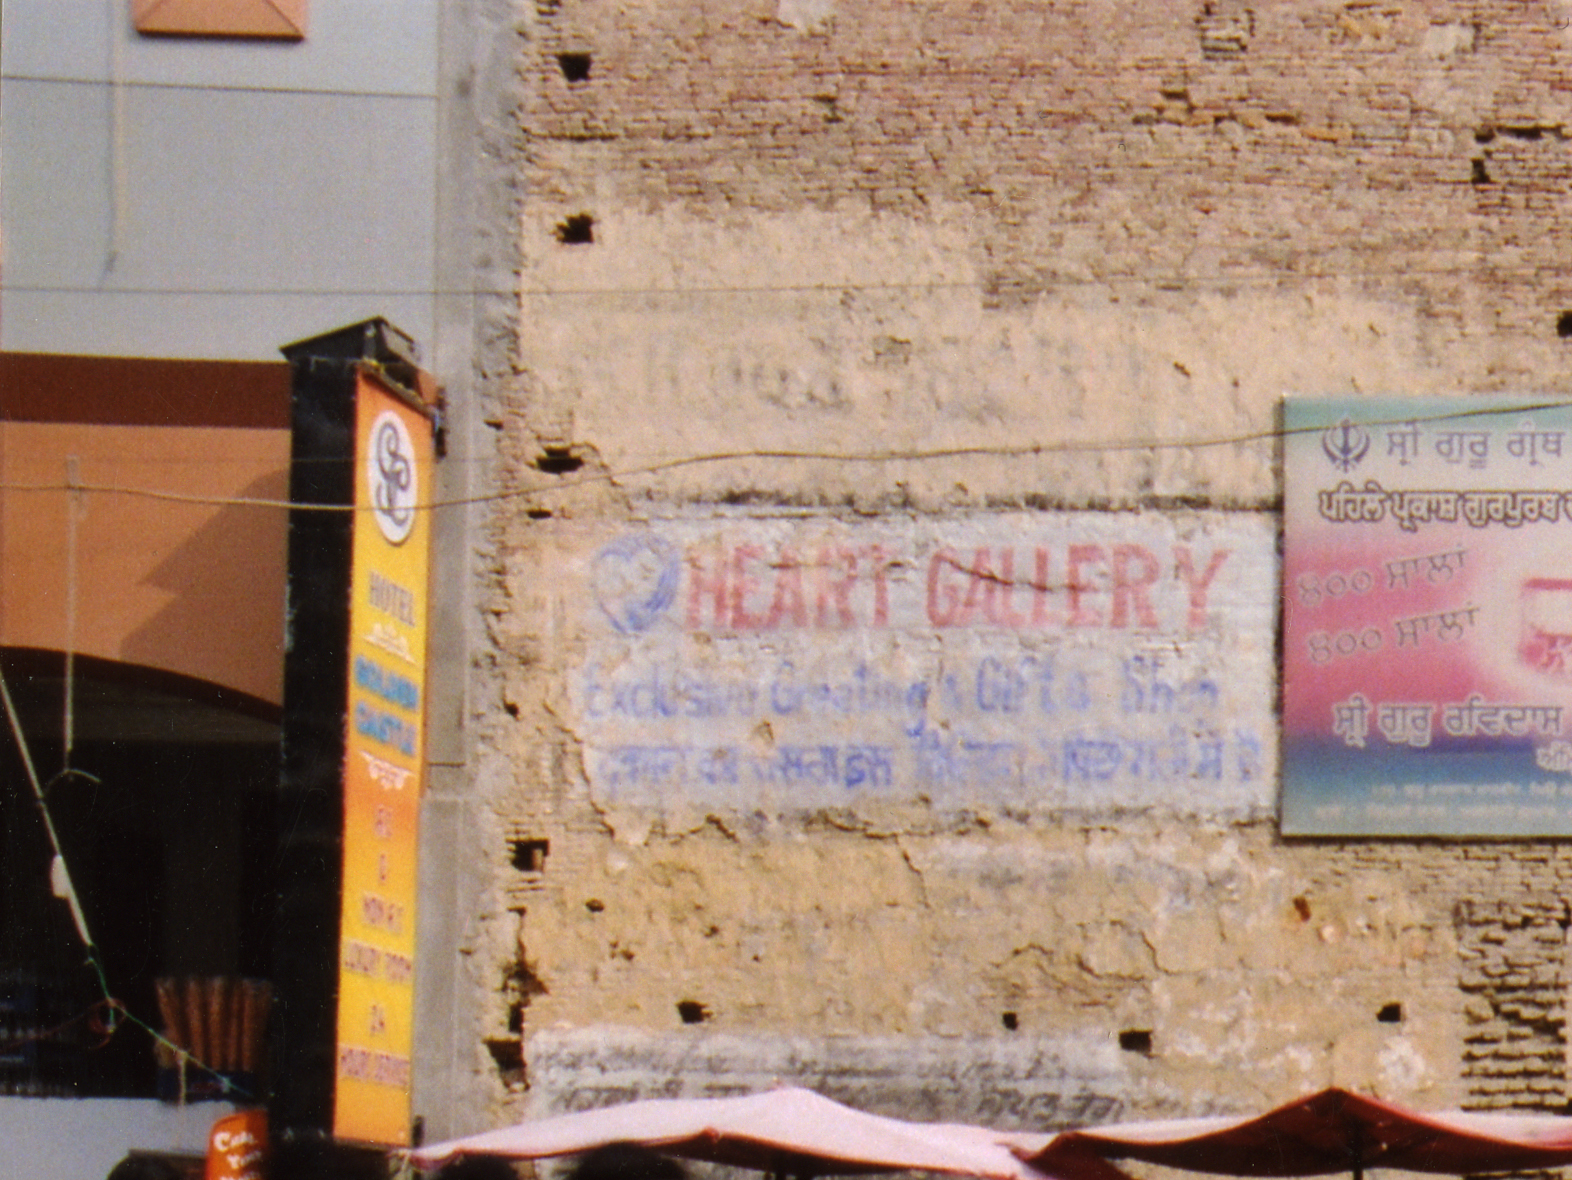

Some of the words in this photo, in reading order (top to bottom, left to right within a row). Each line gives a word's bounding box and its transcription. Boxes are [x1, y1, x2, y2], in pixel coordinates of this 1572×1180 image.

[1436, 432, 1491, 468] ਗੁਰੂ
[1507, 420, 1565, 466] ਗ੍ਰੰਥ
[1318, 480, 1386, 523] ਪਹਿਲੇ
[1462, 490, 1562, 528] ਗੁਰਪੁਰਬ
[688, 545, 893, 629] HEART
[927, 543, 1234, 629] GALLERY
[1443, 692, 1565, 737] ਰਵਿਦਾਸ
